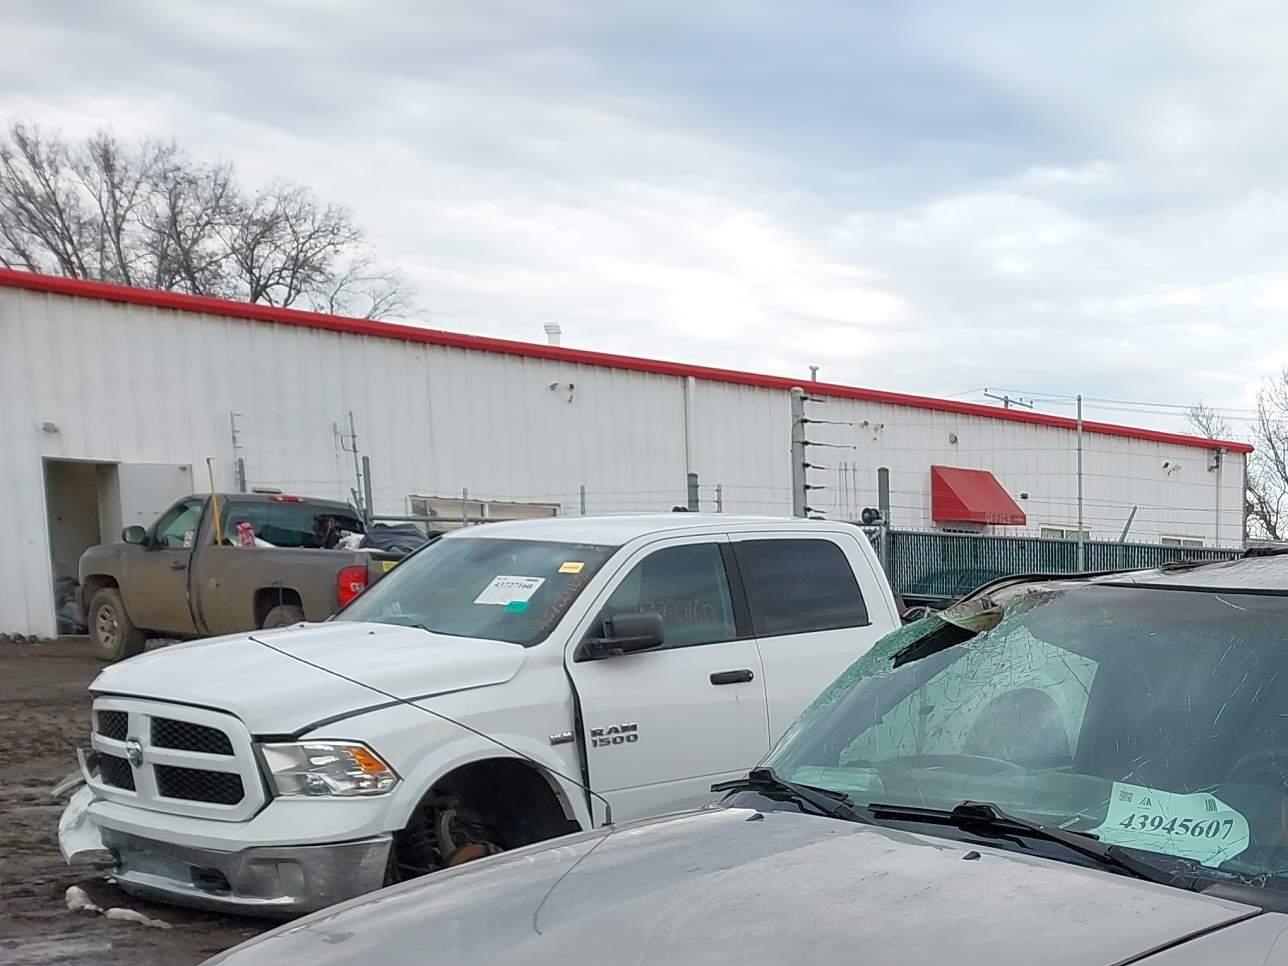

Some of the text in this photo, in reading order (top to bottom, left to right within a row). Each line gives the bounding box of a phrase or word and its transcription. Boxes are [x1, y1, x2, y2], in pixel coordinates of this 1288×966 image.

[590, 722, 638, 737] RAM
[590, 734, 639, 748] 1500
[1119, 812, 1235, 840] 43945607
